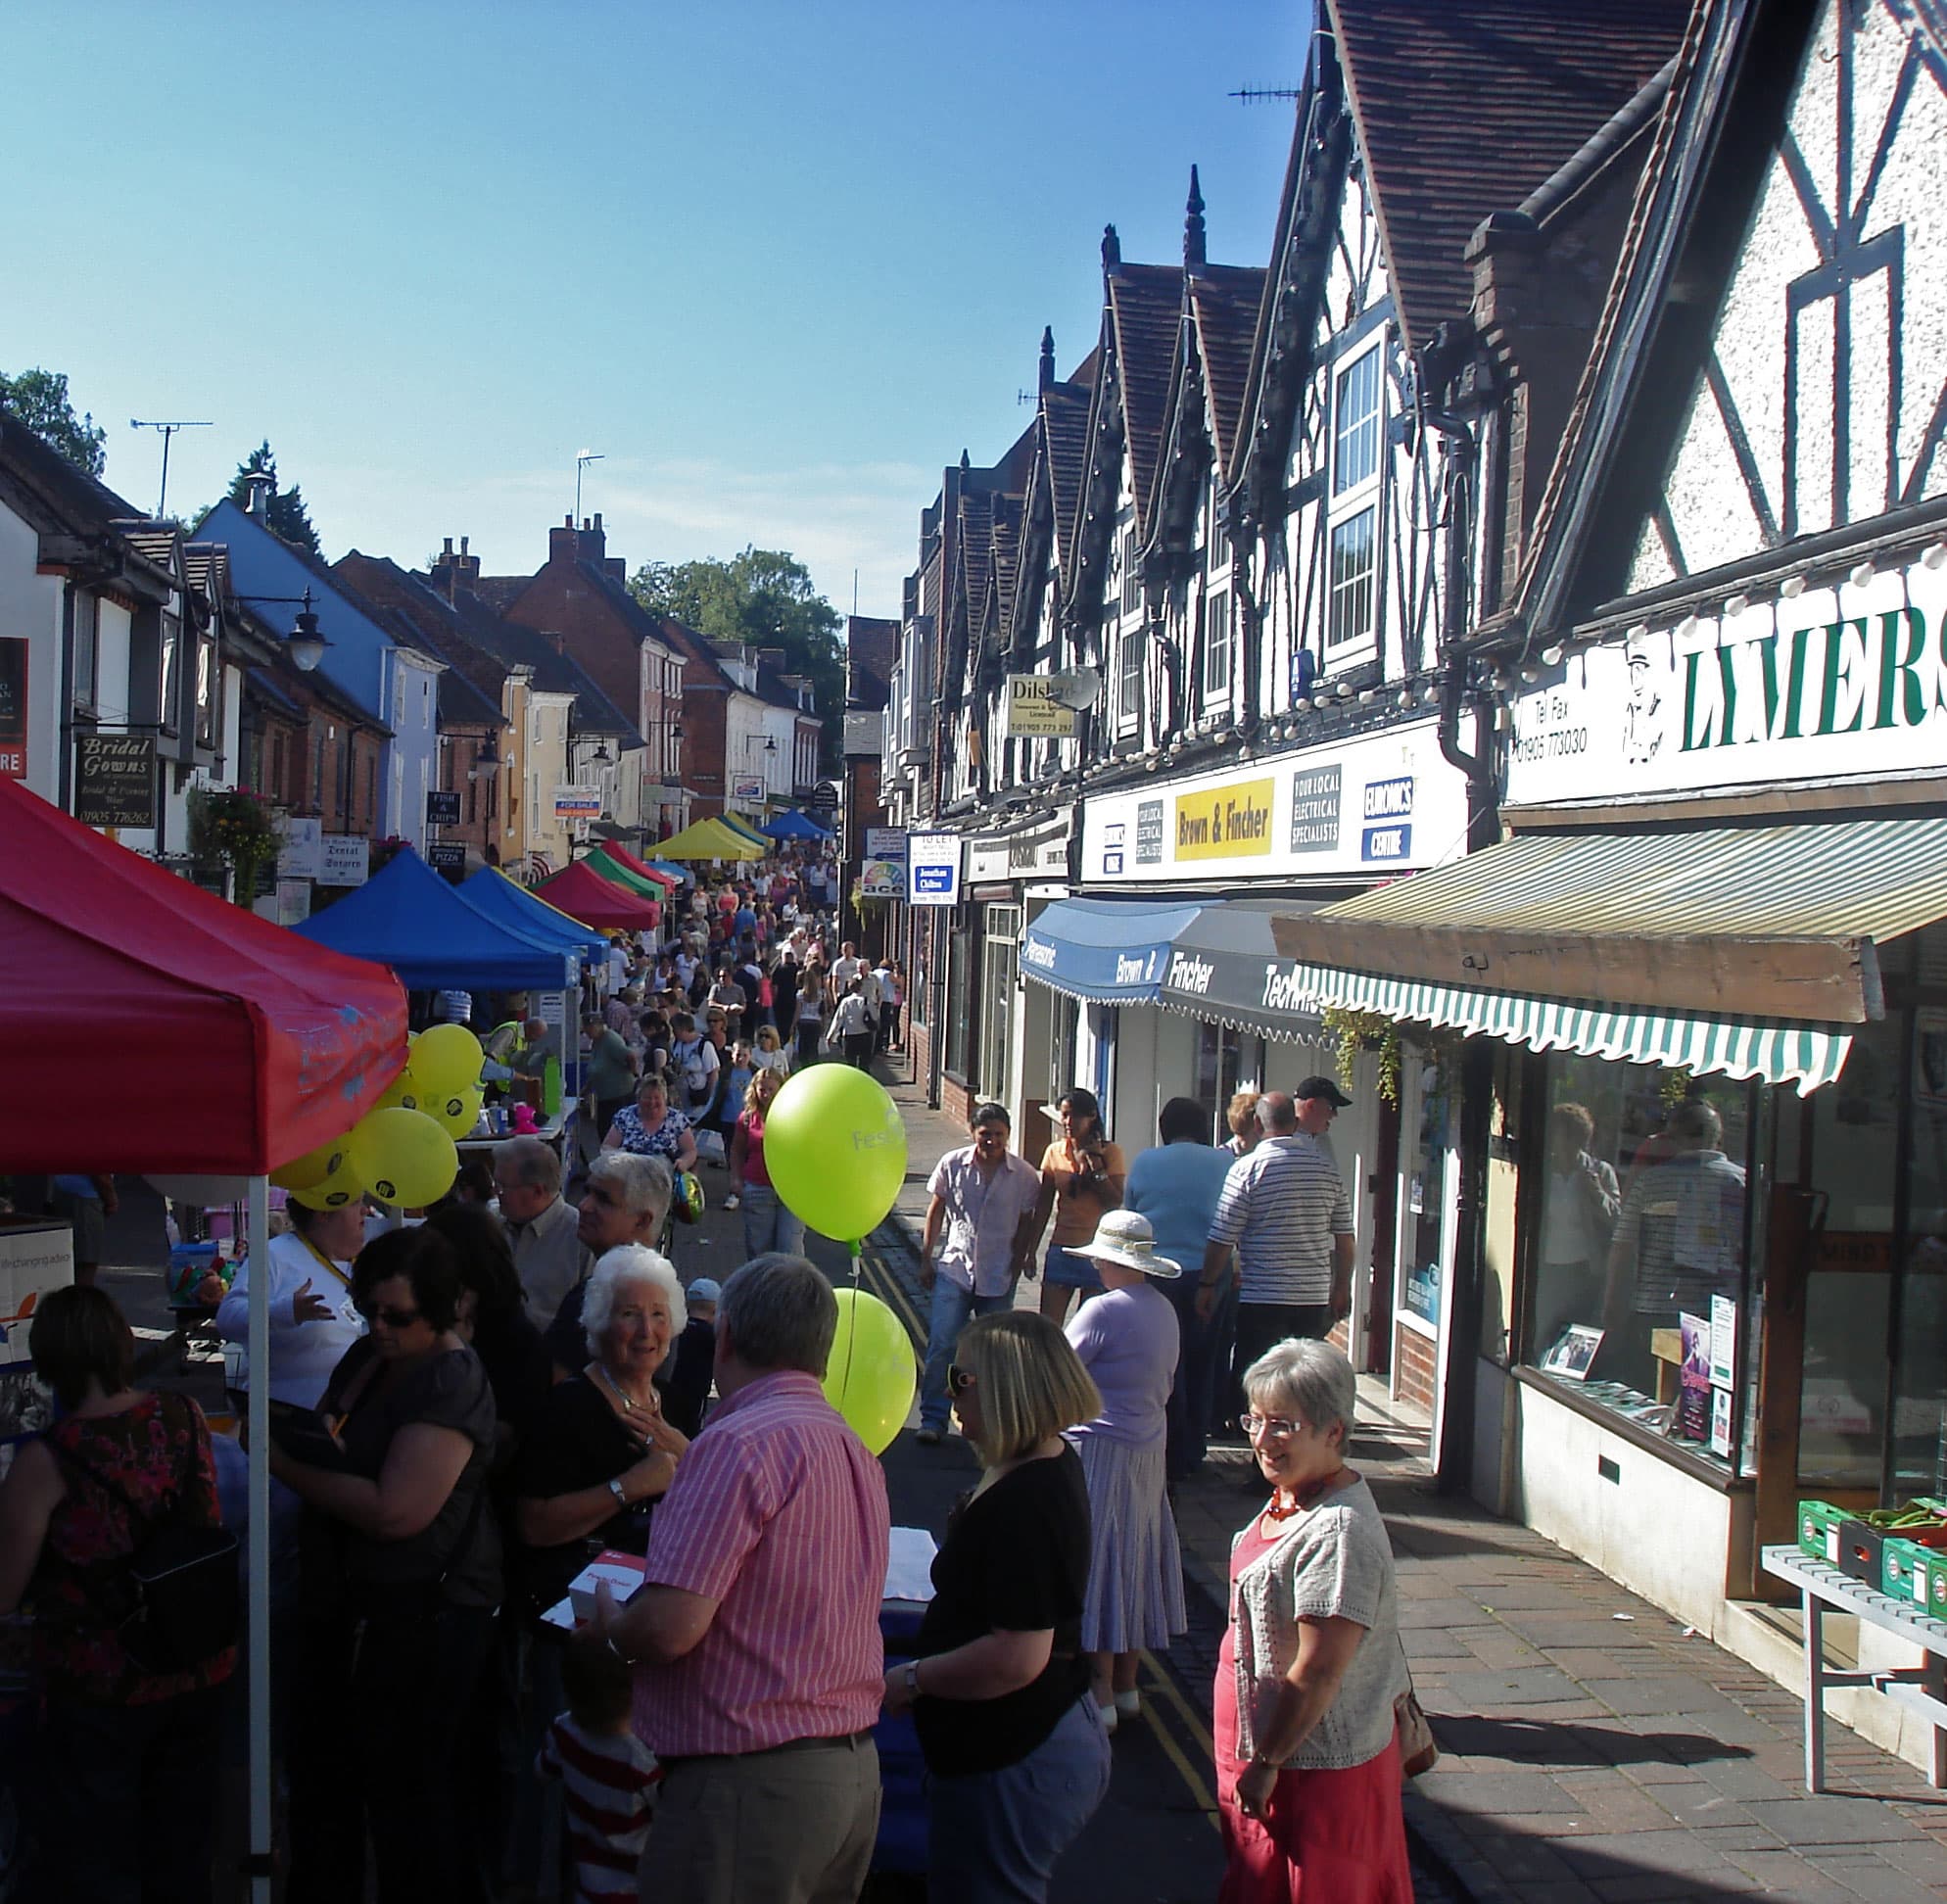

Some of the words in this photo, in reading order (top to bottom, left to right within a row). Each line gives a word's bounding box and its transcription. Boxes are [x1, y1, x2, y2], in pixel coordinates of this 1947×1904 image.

[1013, 682, 1074, 699] Dilshd
[1536, 698, 1547, 725] Tel
[1551, 696, 1568, 722] Fax
[84, 738, 150, 755] Bridal
[1517, 735, 1544, 762] 01905
[1547, 727, 1588, 757] 773030
[84, 755, 149, 776] Gowns
[1295, 779, 1312, 797] YOUR
[1312, 774, 1340, 795] LOCAL
[434, 794, 455, 803] FISH
[1365, 782, 1411, 816] EURONICS
[429, 814, 457, 823] CHIPS
[1179, 811, 1208, 846] Brown
[1212, 802, 1221, 843] &
[1226, 795, 1268, 841] Fincher
[1294, 798, 1338, 822] ELECTRICAL
[1293, 823, 1338, 844] SPECIALISTS
[1371, 830, 1402, 858] CENTRE
[436, 853, 458, 862] PIZZA
[864, 885, 904, 894] ace
[1116, 954, 1144, 983] Brown
[1145, 950, 1157, 980] &
[1167, 951, 1214, 994] Fincher
